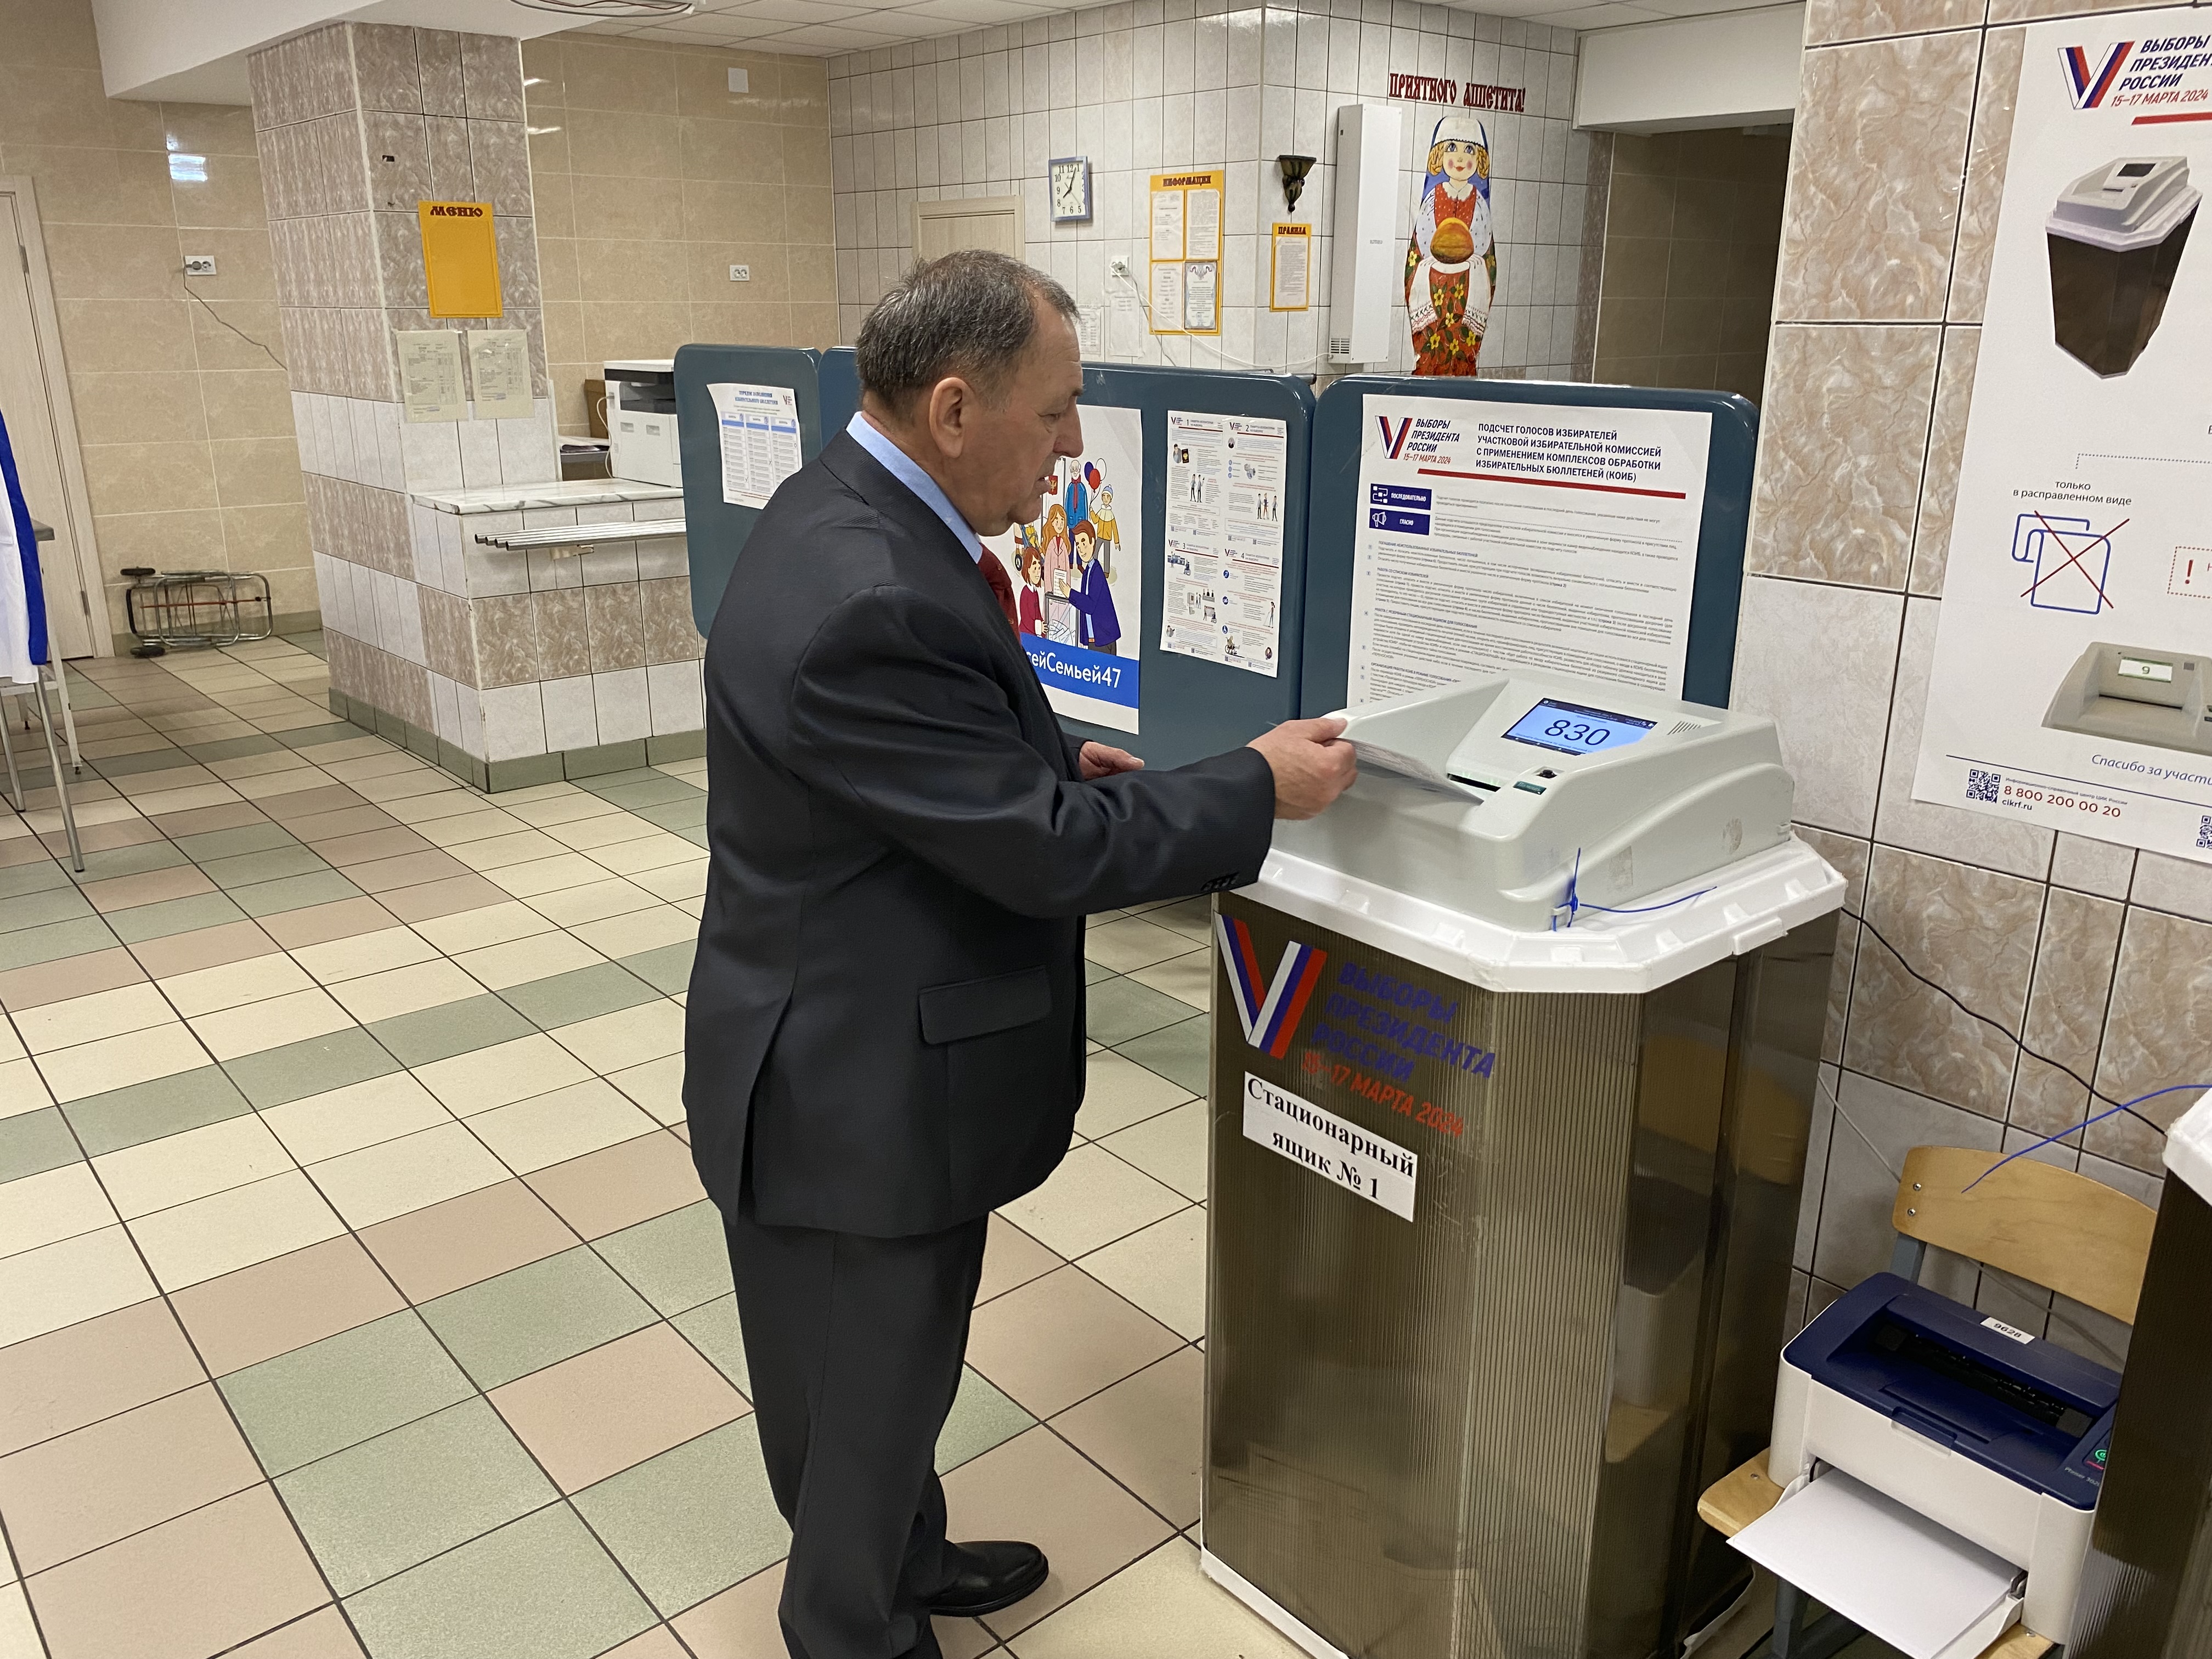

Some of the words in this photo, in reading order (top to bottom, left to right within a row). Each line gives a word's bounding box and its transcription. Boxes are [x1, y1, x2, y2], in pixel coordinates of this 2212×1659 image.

[2140, 35, 2211, 53] ВЫБОРЫ
[2129, 53, 2212, 72] ПРЕЗИДЕН
[2119, 73, 2183, 91] РОССИИ
[1389, 73, 1457, 104] ПРИЯТНОГО
[1463, 82, 1526, 112] АППЕТИТА!
[2141, 91, 2180, 105] МАРТА
[2180, 89, 2209, 102] 2024
[1066, 164, 1074, 173] 12
[1054, 174, 1061, 182] 10
[430, 206, 483, 218] МЕНЮ
[1278, 227, 1306, 235] ПРАВИЛА
[1416, 419, 1451, 429] ВЫБОРЫ
[1479, 424, 1514, 434] ПОДСЧЕТ
[1516, 426, 1554, 436] ГОЛОСОВ
[1556, 428, 1617, 440] ИЗБИРАТЕЛЕЙ
[1411, 431, 1460, 442] ПРЕЗИДЕНТА
[1477, 435, 1528, 447] УЧАСТКОВОЙ
[1531, 439, 1602, 452] ИЗБИРАТЕЛЬНОЙ
[1605, 444, 1661, 456] КОМИССИЕЙ
[1407, 442, 1437, 453] РОССИИ
[1419, 454, 1437, 463] МАРТА
[1437, 456, 1451, 465] 2024
[1483, 448, 1544, 460] ПРИМЕНЕНИЕМ
[1547, 453, 1606, 465] КОМПЛЕКСОВ
[1609, 458, 1661, 470] ОБРАБОТКИ
[1476, 460, 1544, 473] ИЗБИРАТЕЛЬНЫХ
[1547, 466, 1604, 478] БЮЛЛЕТЕНЕЙ
[1606, 471, 1637, 483] (КОИБ)
[2055, 481, 2091, 490] только
[2021, 490, 2103, 503] расправленном
[2106, 496, 2131, 506] виде
[2142, 666, 2150, 675] 9
[1544, 720, 1610, 746] 830
[2091, 754, 2145, 772] Спасибо
[2147, 766, 2162, 776] за
[2002, 799, 2033, 810] cikrf.ru
[2004, 786, 2012, 795] 8
[2016, 788, 2043, 802] 800
[2047, 794, 2074, 808] 200
[2079, 801, 2098, 812] 00
[2102, 806, 2121, 817] 20
[1338, 961, 1458, 1025] ВЫБОРЫ
[1324, 993, 1496, 1079] ПРЕЗИДЕНТА
[1312, 1023, 1415, 1083] РОССИИ
[1350, 1073, 1416, 1117] МАРТА
[1415, 1101, 1464, 1139] 2024
[1248, 1077, 1415, 1178] Стационарный
[1272, 1132, 1331, 1173] ящик
[1336, 1160, 1362, 1190] №
[1370, 1178, 1379, 1200] 1
